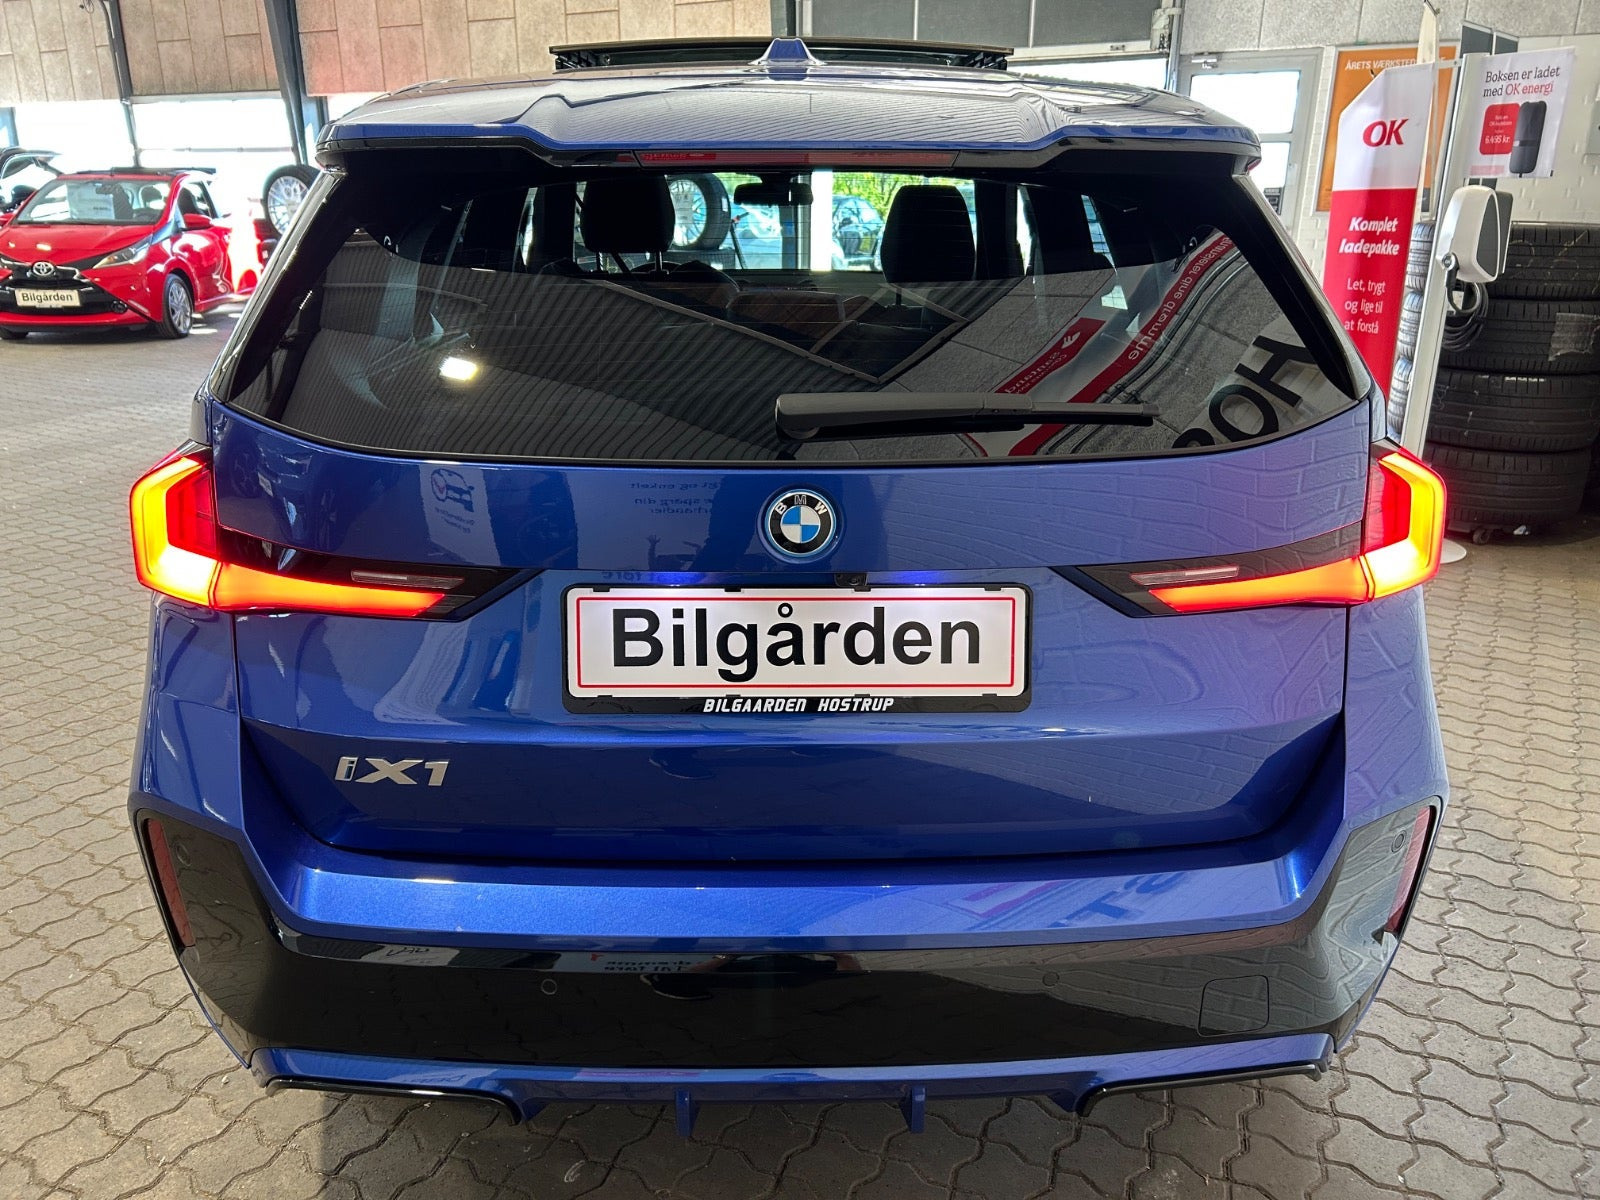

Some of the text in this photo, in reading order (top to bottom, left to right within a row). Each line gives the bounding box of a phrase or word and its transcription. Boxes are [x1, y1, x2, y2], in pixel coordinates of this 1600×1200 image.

[1345, 59, 1371, 71] ÅRETS
[1485, 66, 1560, 83] Boksen er ladet
[1483, 81, 1554, 97] med OK energi
[1363, 119, 1409, 147] OK
[1349, 216, 1398, 235] Komplet
[1339, 239, 1400, 257] ladepakke
[1347, 278, 1386, 296] Let, trygt
[22, 292, 73, 303] Bilgården
[1344, 299, 1384, 315] og lige til
[1344, 319, 1379, 334] at forstå
[775, 494, 828, 515] BMW
[613, 602, 981, 682] Bilgården
[703, 697, 894, 713] BILGAARDEN HOSTRUP
[334, 756, 449, 786] iX1
